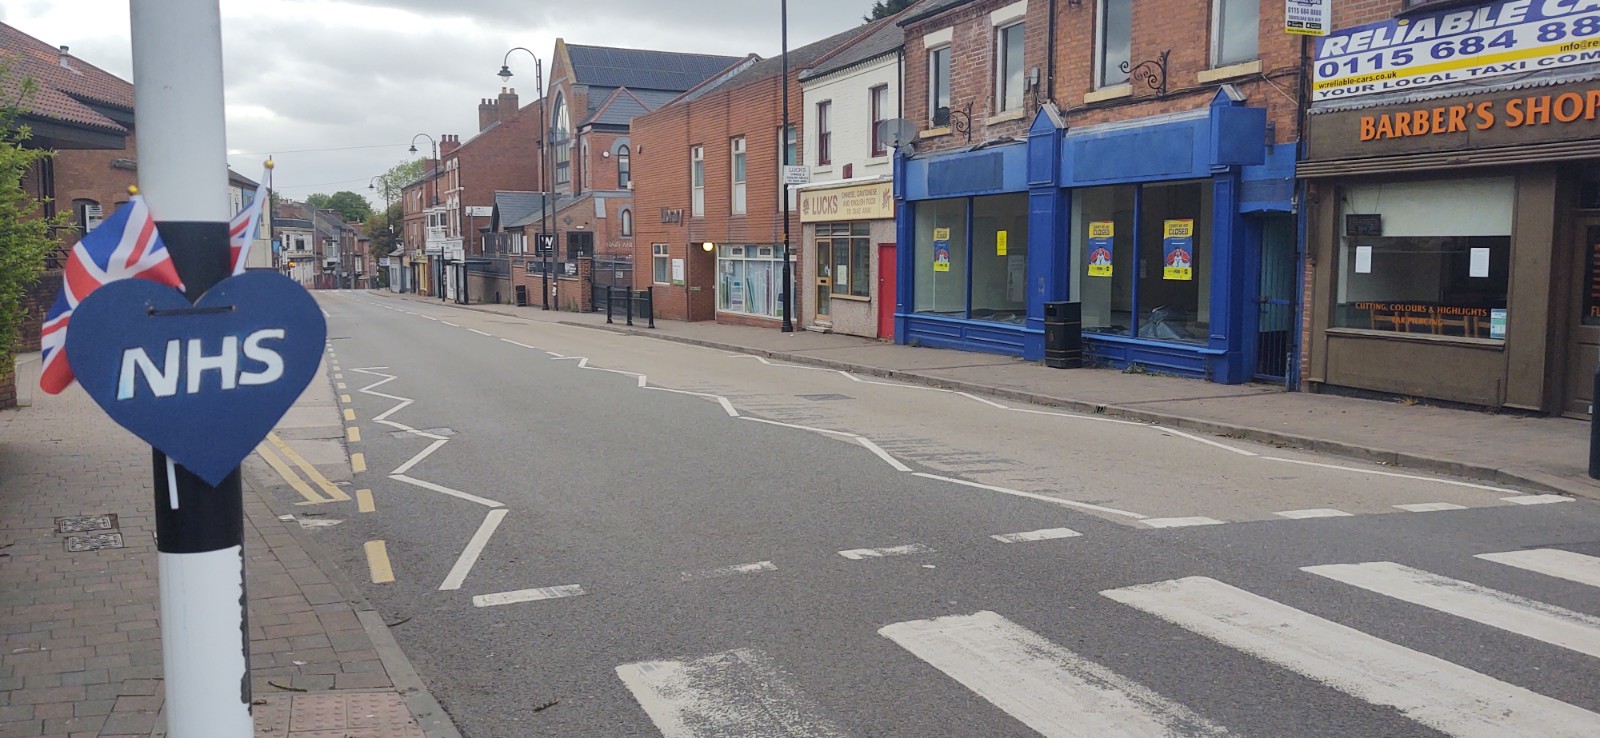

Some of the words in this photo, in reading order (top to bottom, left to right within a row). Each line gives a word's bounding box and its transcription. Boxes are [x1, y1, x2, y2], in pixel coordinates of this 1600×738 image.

[1318, 48, 1414, 78] 0115
[1430, 30, 1518, 60] 684
[1537, 16, 1600, 42] 88
[1318, 71, 1397, 89] w:reliable-cars.co.uk
[1320, 84, 1375, 98] YOUR
[1383, 73, 1458, 88] LOCAL
[1466, 62, 1526, 76] TAXI
[1360, 102, 1495, 141] BARBER'S
[812, 194, 838, 215] LUCKS
[1390, 304, 1426, 313] COLOURS
[1437, 306, 1488, 316] HIGHLIGHTS
[117, 328, 285, 400] NHS
